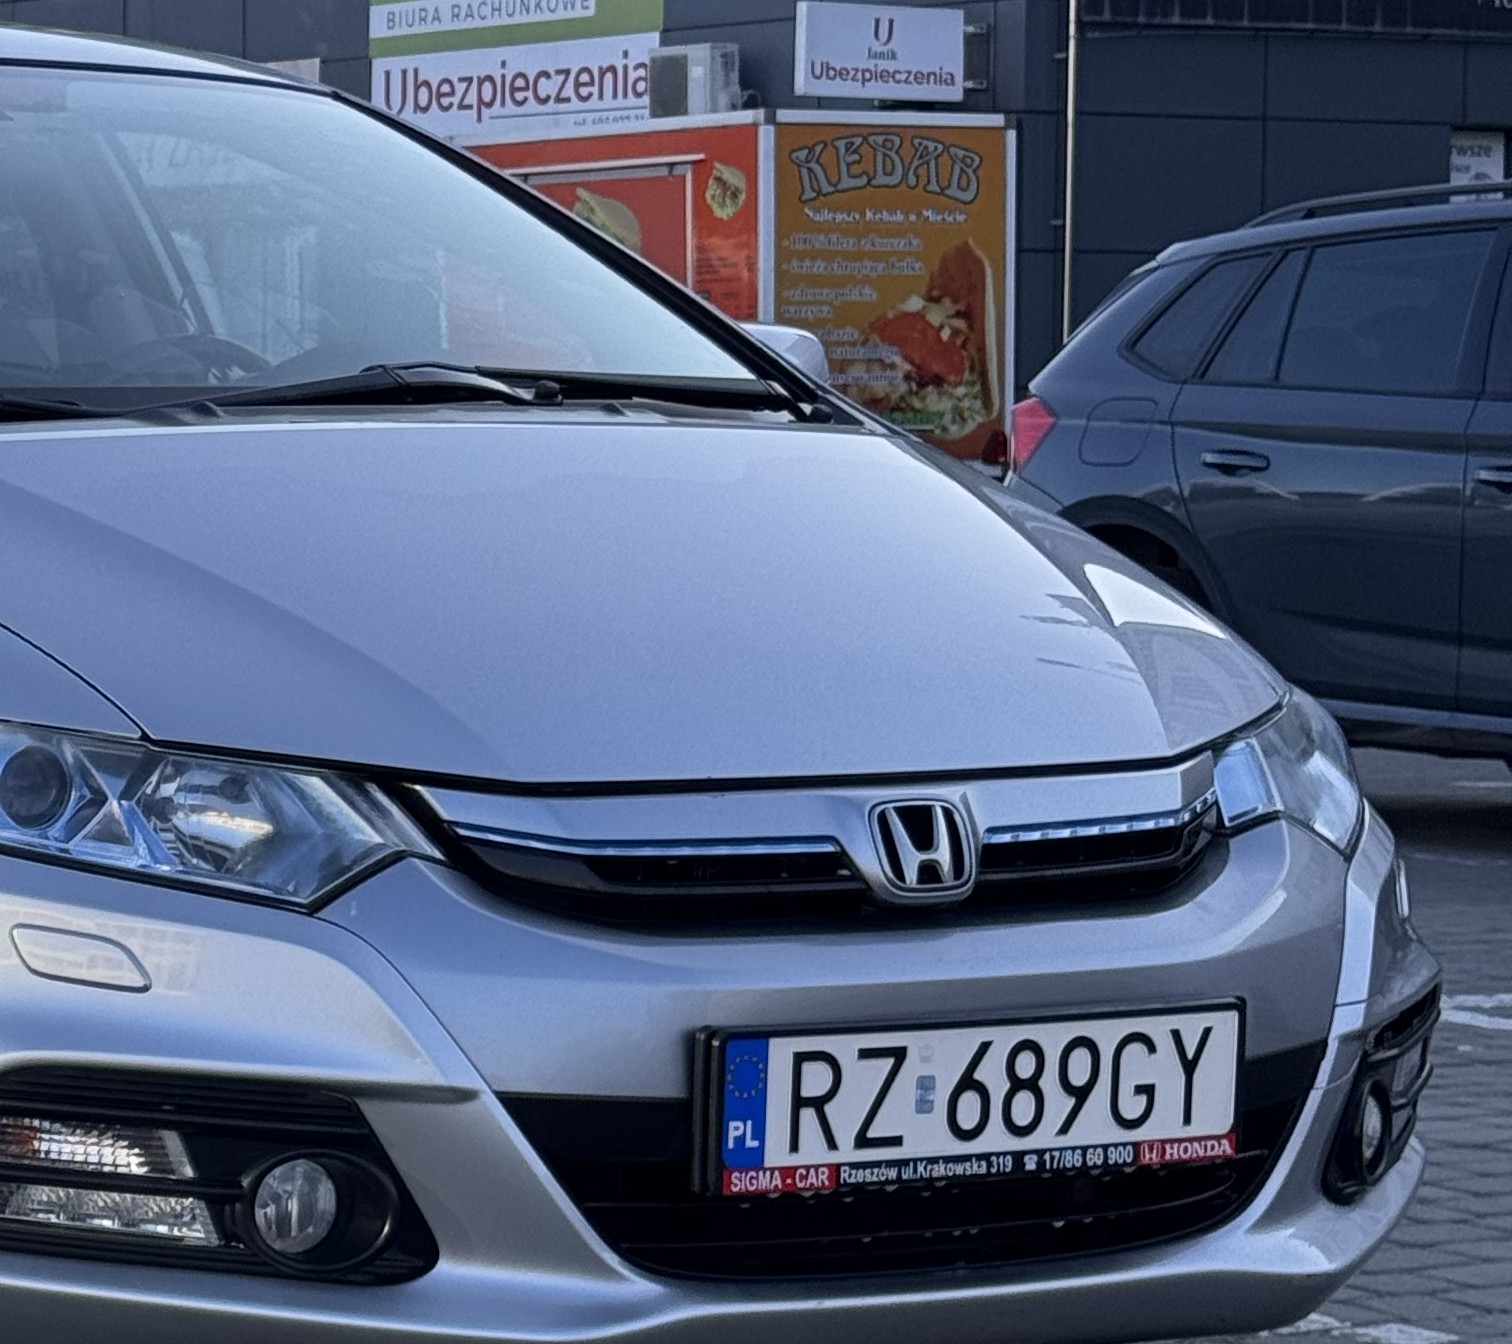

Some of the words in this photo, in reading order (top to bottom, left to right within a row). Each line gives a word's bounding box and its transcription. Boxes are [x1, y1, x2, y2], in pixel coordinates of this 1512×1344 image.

[386, 6, 443, 31] BIURA
[382, 49, 650, 124] Ubezpieczenia
[810, 60, 956, 88] Ubezpieczenia
[789, 132, 983, 205] KEBAB
[788, 1045, 909, 1154] RZ
[945, 1025, 1215, 1143] 689GY
[726, 1120, 761, 1151] PL
[730, 1169, 783, 1193] SIGMA
[795, 1167, 830, 1190] CAR
[840, 1164, 899, 1185] Rzeszów
[990, 1154, 1013, 1175] 319
[1043, 1149, 1083, 1170] 17/86
[1107, 1144, 1134, 1165] 900
[1165, 1138, 1232, 1160] HONDA
